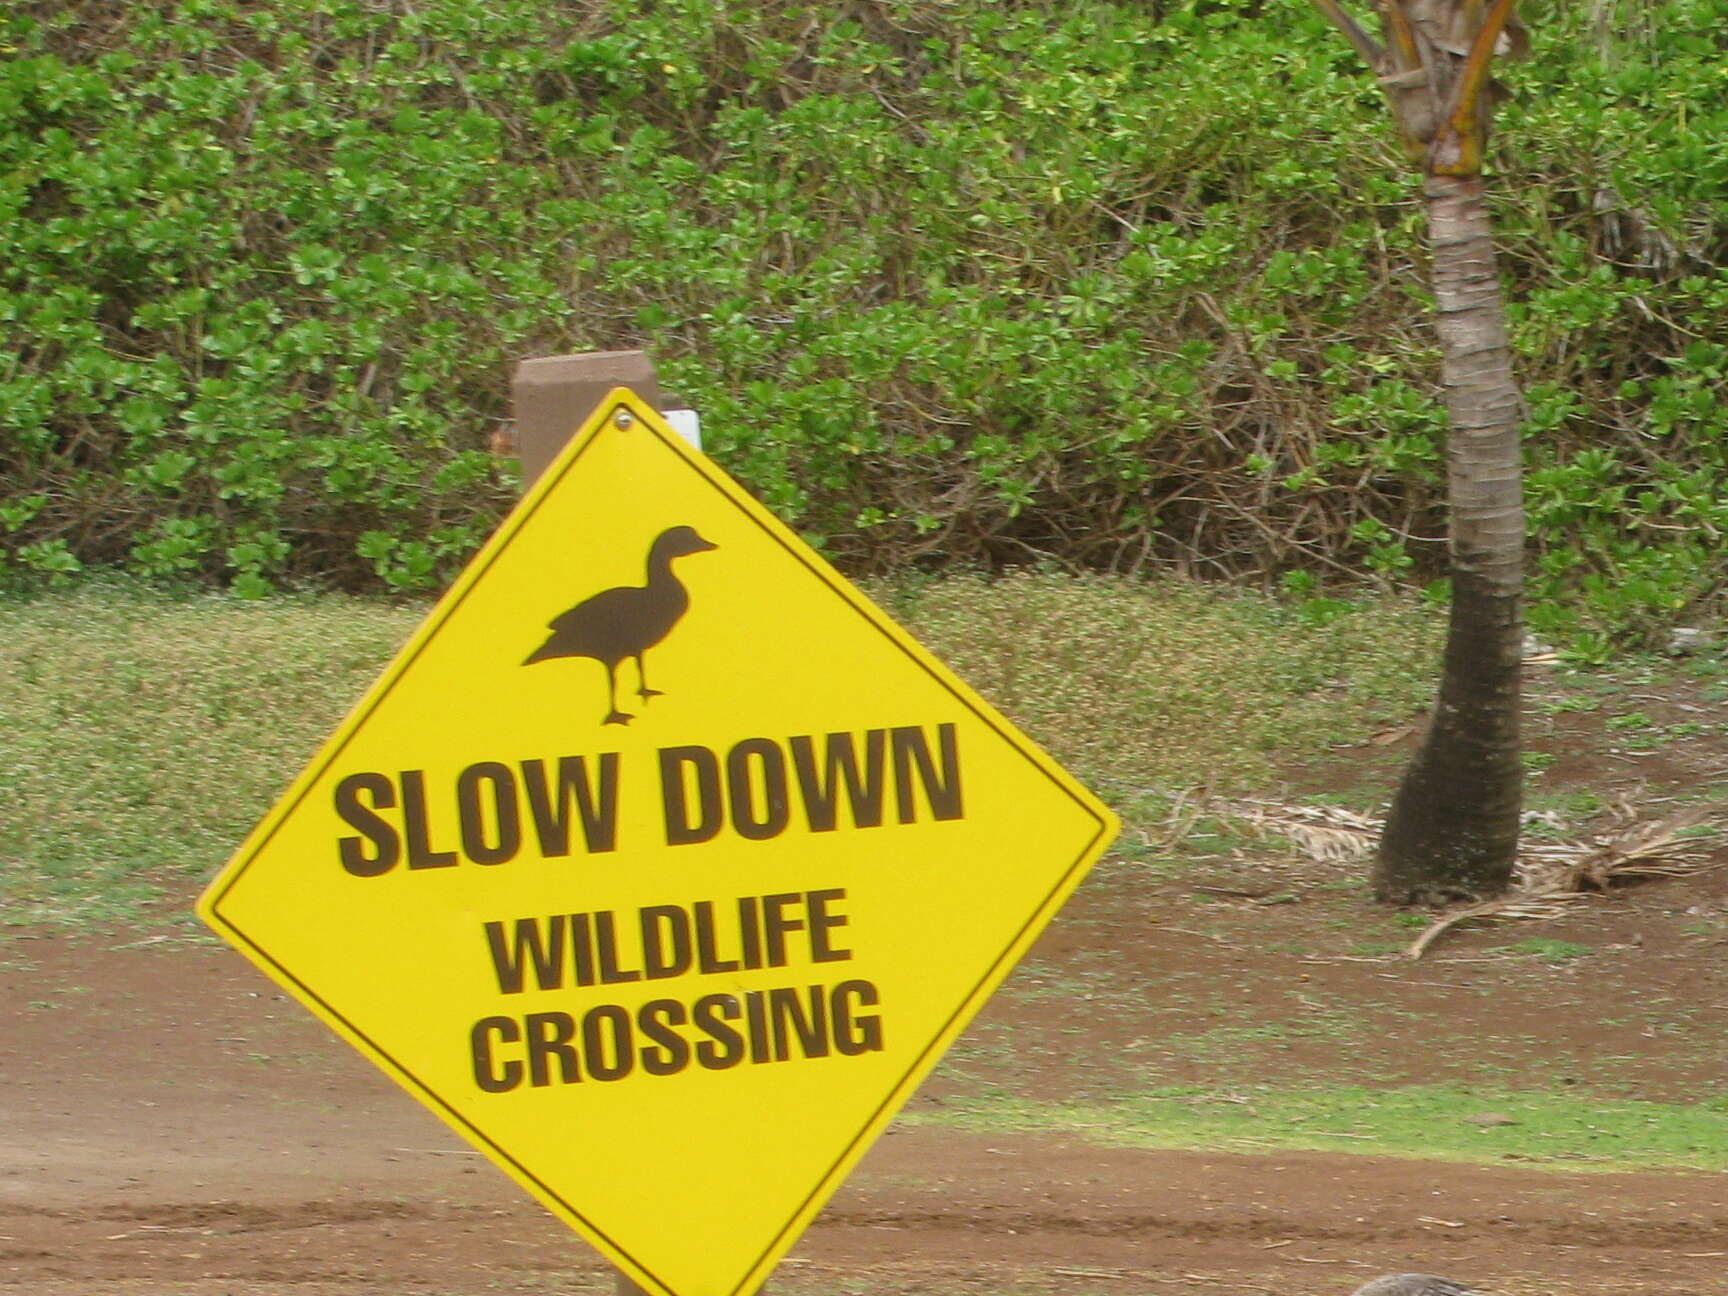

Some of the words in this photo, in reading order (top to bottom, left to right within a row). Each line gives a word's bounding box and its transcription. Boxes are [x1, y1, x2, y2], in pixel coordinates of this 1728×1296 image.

[334, 753, 618, 877] SLOW
[658, 723, 962, 846] DOWN
[484, 889, 850, 994] WILDLIFE
[470, 980, 881, 1093] CROSSING
